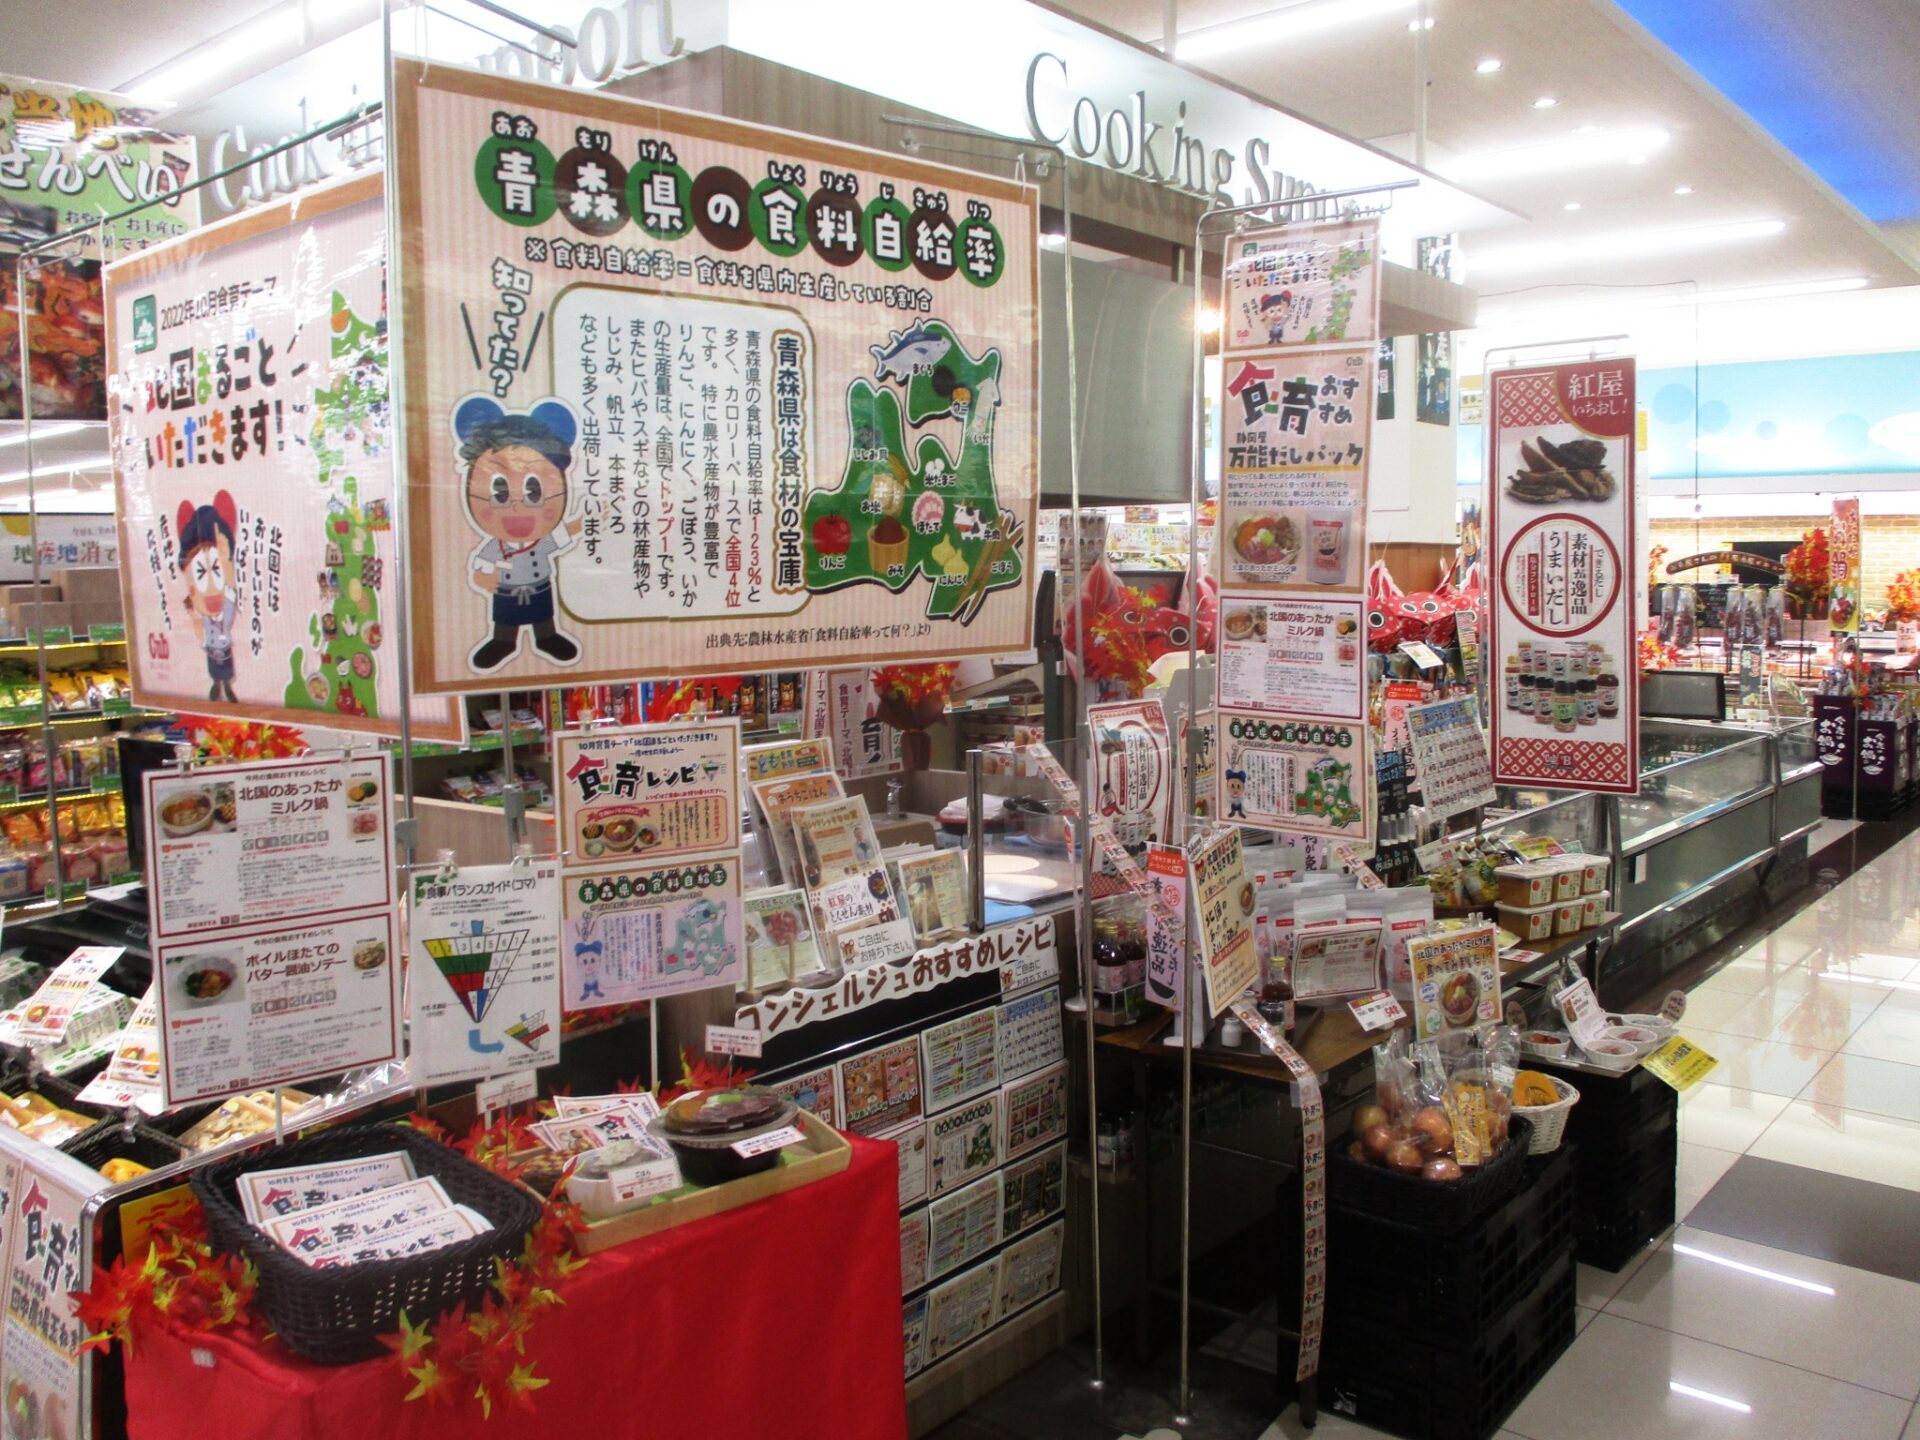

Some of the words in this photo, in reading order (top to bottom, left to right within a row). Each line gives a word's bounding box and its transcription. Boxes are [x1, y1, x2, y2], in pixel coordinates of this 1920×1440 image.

[1026, 52, 1235, 208] Cooking
[492, 111, 537, 140] あお
[576, 126, 611, 153] もり
[638, 139, 678, 166] けん
[768, 161, 806, 184] しょく
[820, 171, 858, 195] りょう
[967, 200, 991, 220] りつ
[495, 149, 998, 281] 青森県の食料自給率
[1568, 370, 1624, 400] 紅屋
[776, 336, 802, 587] 青森県は食材の宝庫
[1228, 443, 1363, 468] 万能だしパック
[819, 556, 847, 569] りんご
[1571, 533, 1588, 615] 素材が逸品
[1546, 531, 1564, 625] うまいだし
[1269, 612, 1334, 624] 北国のあったか
[238, 778, 343, 801] 北国のあったか
[270, 797, 329, 815] ミルク鍋
[857, 930, 889, 948] ご自由に
[246, 942, 340, 967] ボイルほたての
[737, 919, 1052, 1034] コンシェルジュおすすめレシピ
